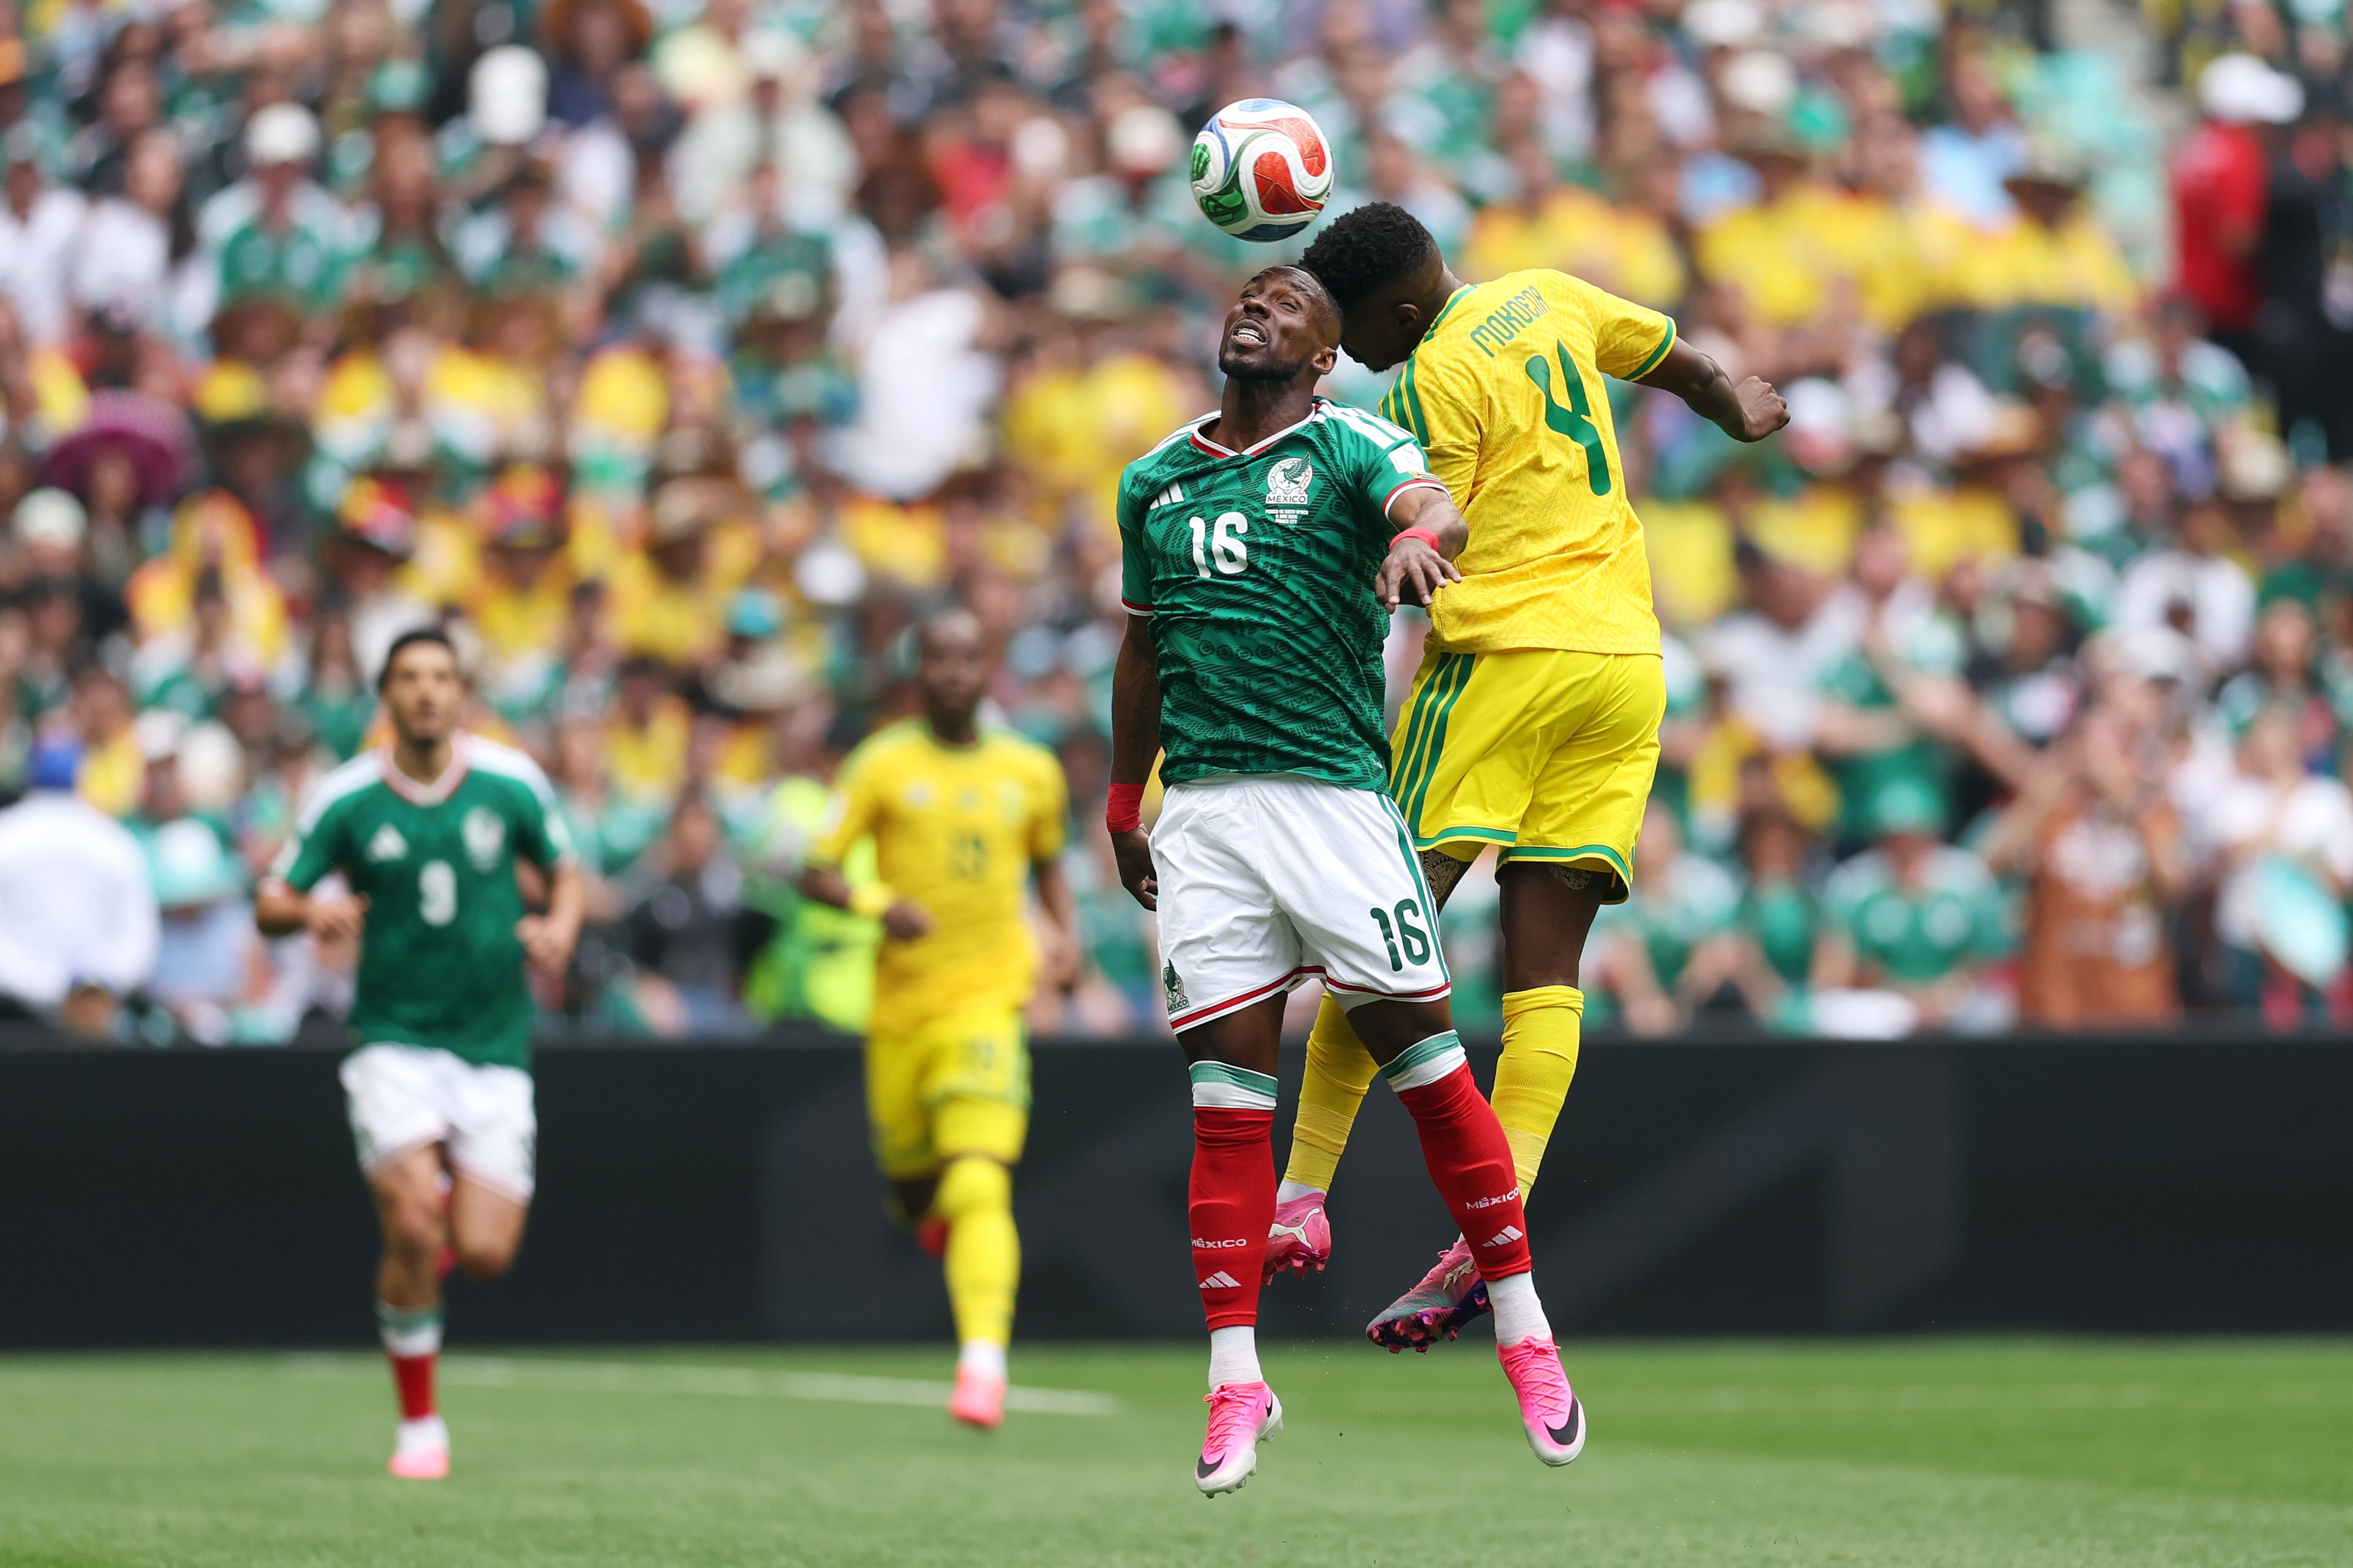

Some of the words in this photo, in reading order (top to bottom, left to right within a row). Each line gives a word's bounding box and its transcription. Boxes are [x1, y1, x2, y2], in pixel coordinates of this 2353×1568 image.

[1525, 338, 1611, 497] 4
[1267, 493, 1306, 503] MÉXICO
[1188, 512, 1249, 578] 16
[420, 860, 457, 926] 9
[1370, 898, 1431, 972] 16
[1466, 1187, 1519, 1210] MÉXICO
